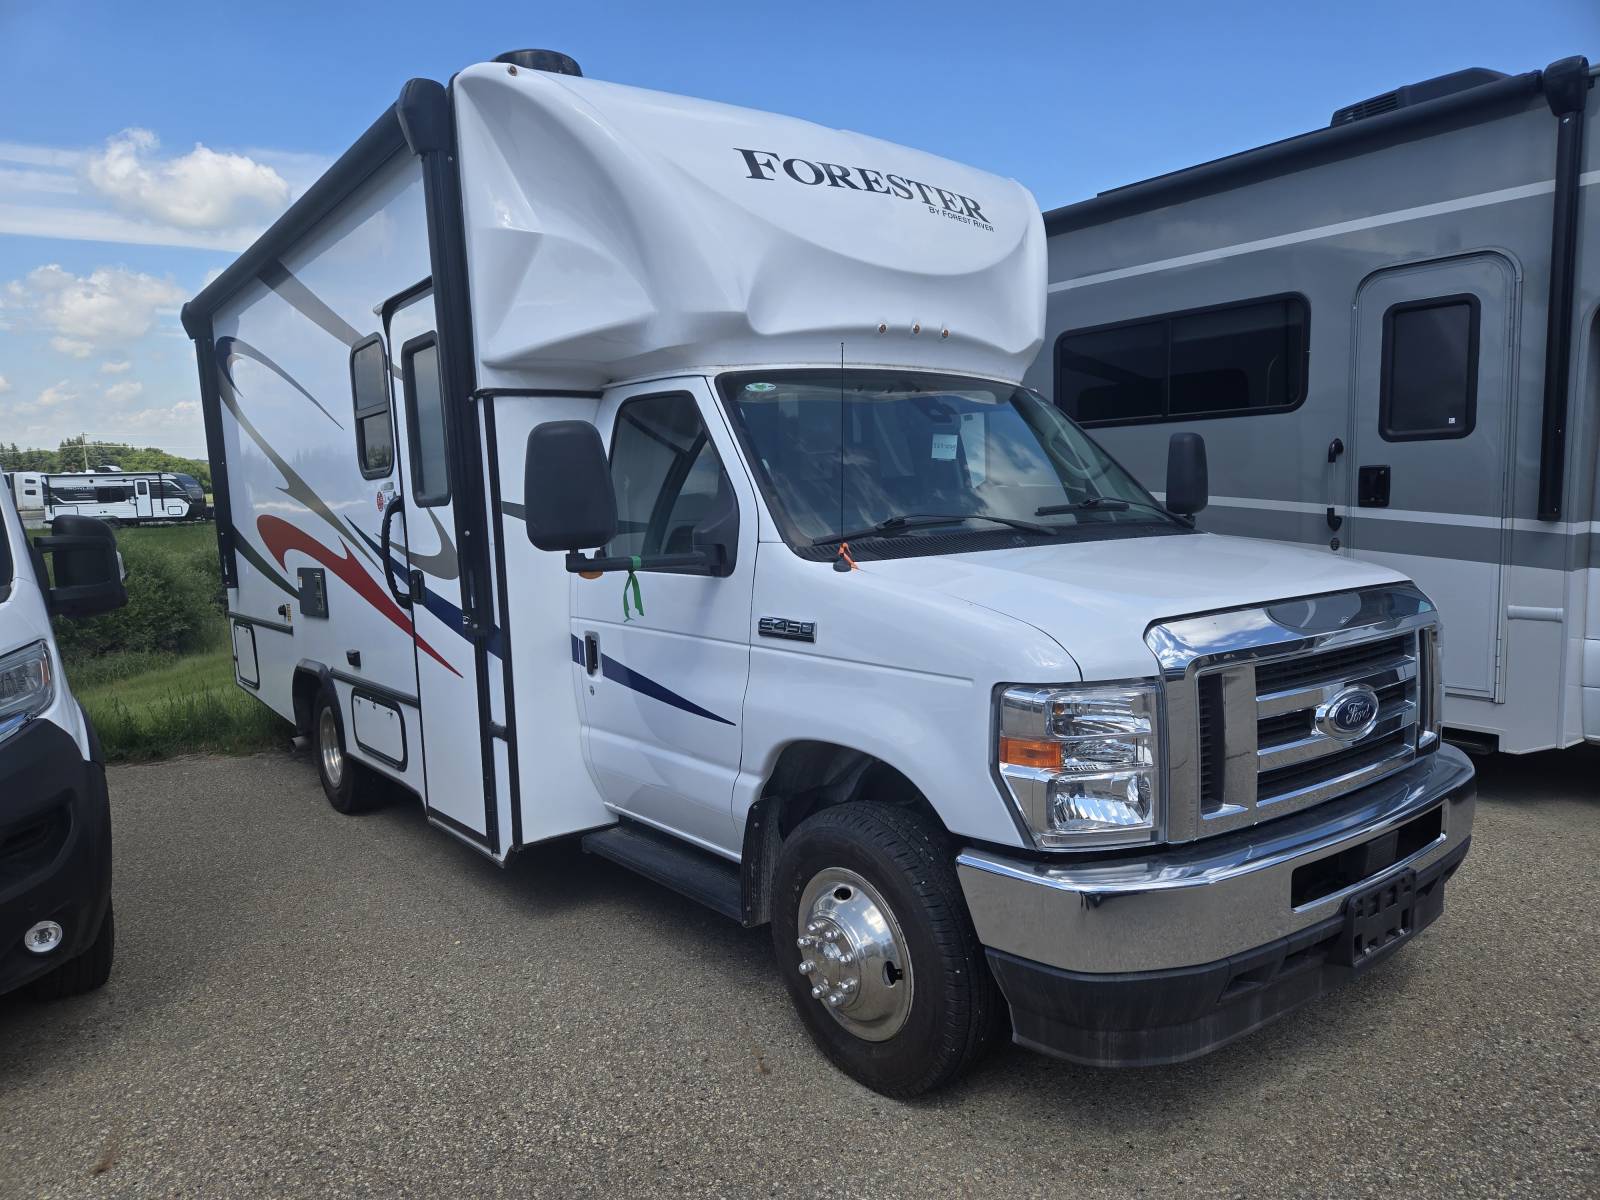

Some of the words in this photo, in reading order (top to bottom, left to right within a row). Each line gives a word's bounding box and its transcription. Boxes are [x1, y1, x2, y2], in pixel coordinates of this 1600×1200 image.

[732, 147, 991, 224] FORESTER
[928, 205, 940, 215] BY
[942, 210, 971, 225] FOREST
[973, 219, 995, 233] RIVER
[1345, 700, 1371, 725] Ford
